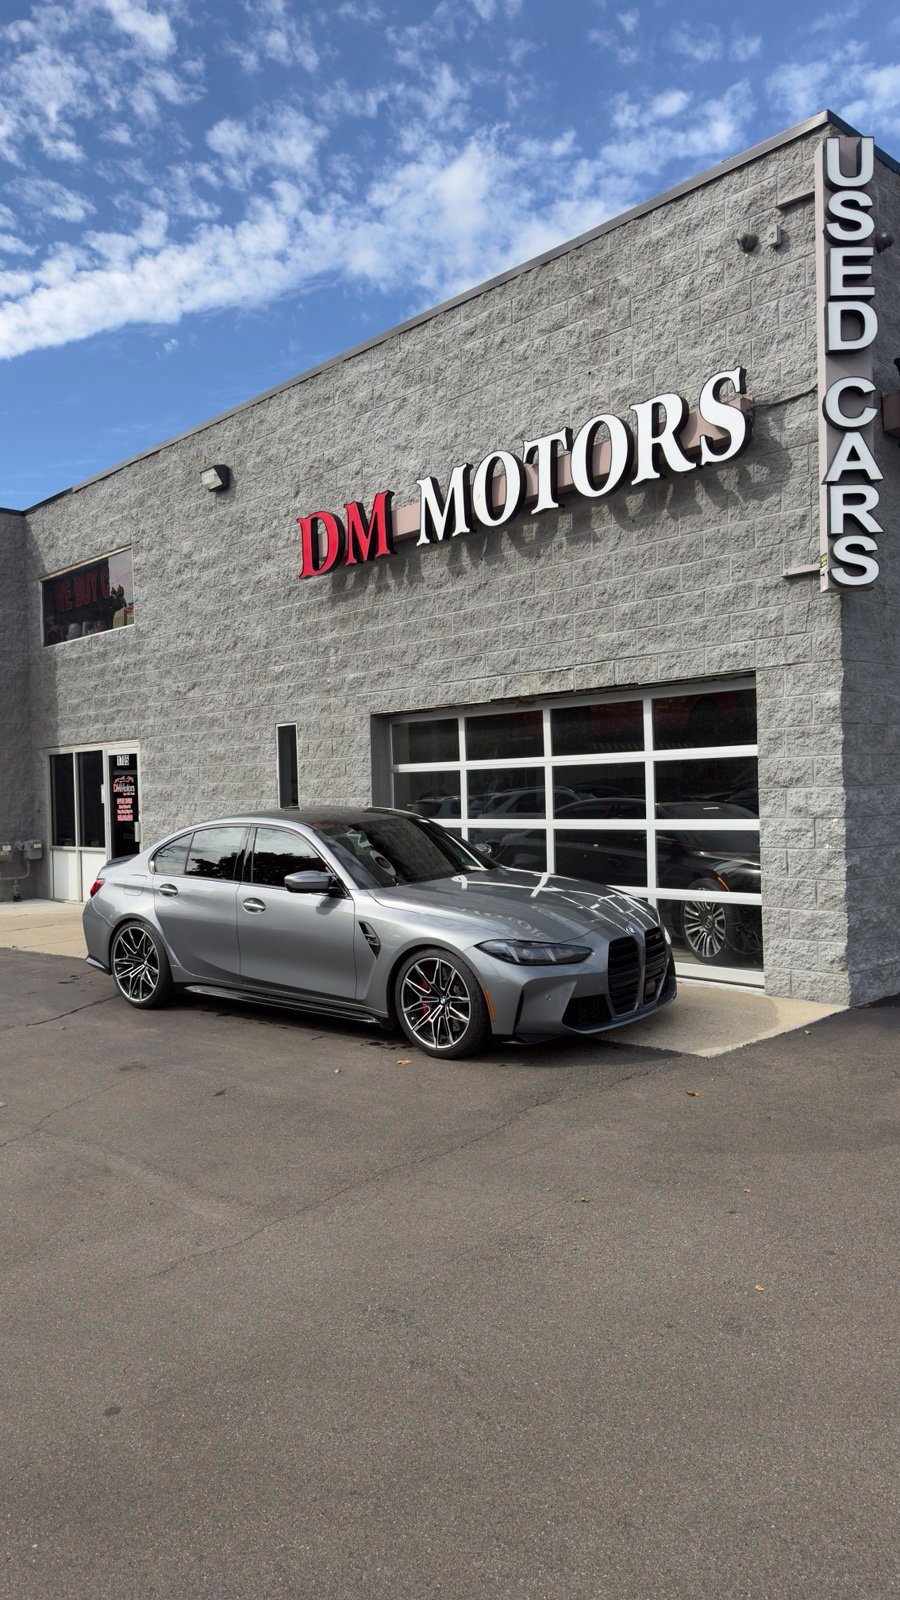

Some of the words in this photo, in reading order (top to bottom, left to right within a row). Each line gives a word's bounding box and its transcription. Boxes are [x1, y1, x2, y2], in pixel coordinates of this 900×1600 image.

[824, 136, 879, 355] USED
[297, 490, 396, 579] DM
[415, 366, 753, 547] MOTORS
[822, 376, 884, 588] CARS
